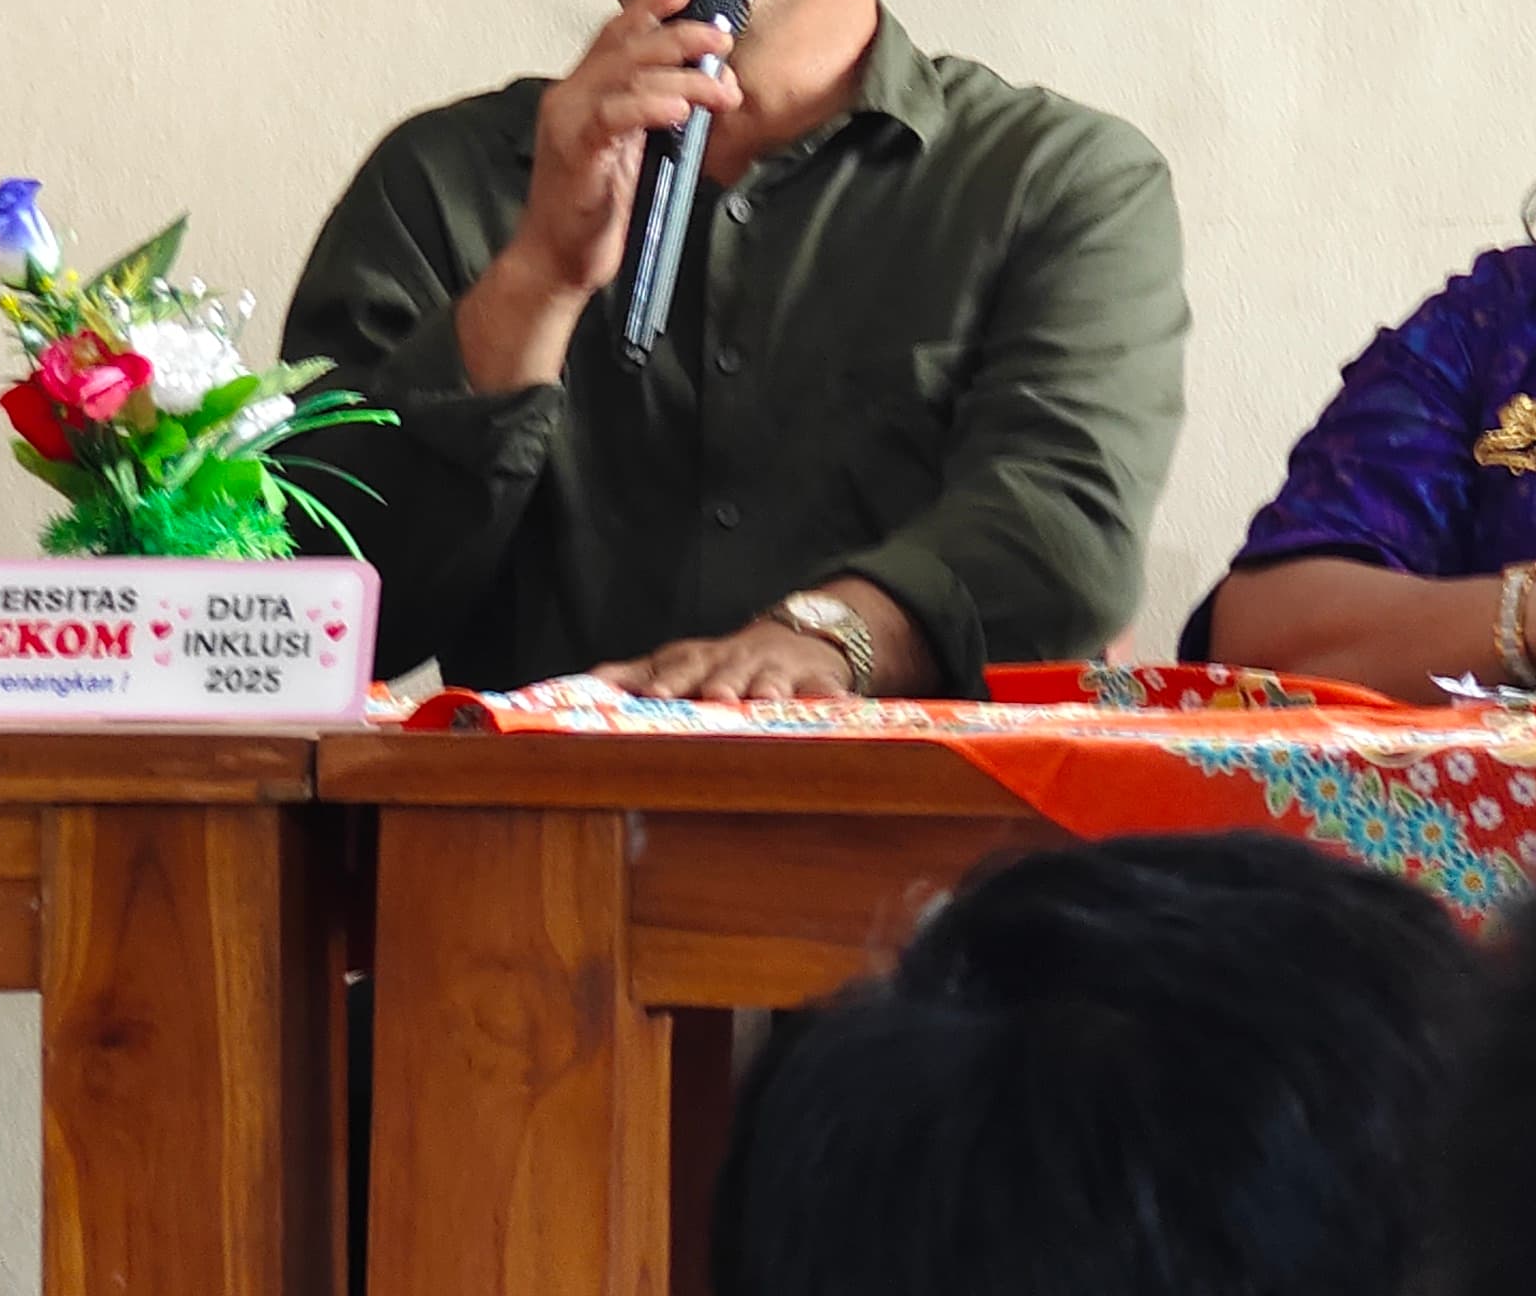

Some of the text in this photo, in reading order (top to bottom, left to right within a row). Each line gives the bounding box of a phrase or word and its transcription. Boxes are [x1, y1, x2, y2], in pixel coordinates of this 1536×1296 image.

[207, 594, 295, 622] DUTA
[183, 630, 311, 657] INKLUSI
[205, 666, 282, 694] 2025
